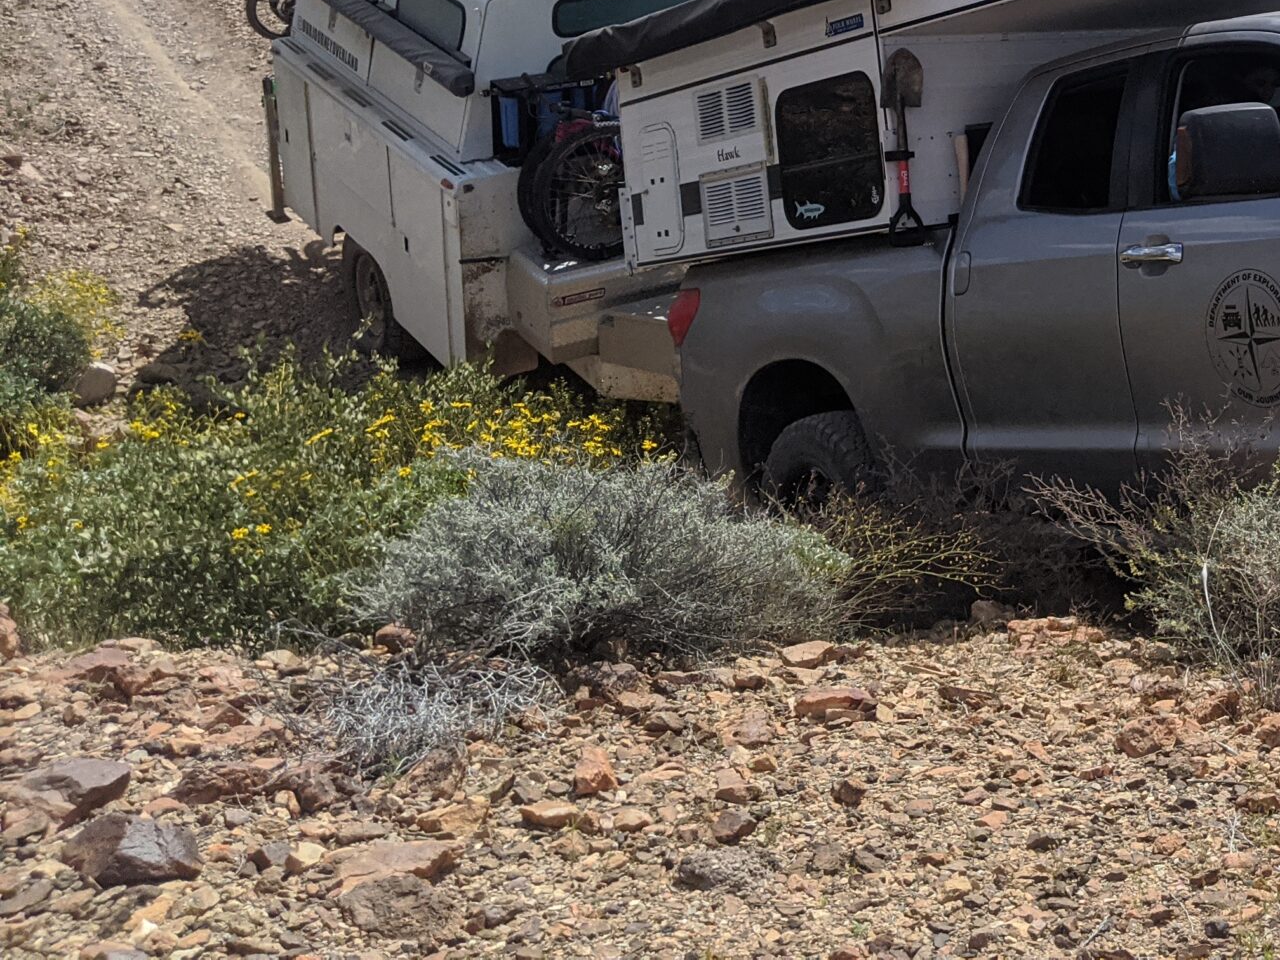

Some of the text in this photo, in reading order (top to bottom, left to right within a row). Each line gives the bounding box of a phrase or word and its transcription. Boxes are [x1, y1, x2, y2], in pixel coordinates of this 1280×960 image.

[717, 146, 741, 162] Hawk
[1208, 275, 1240, 328] DEPARTMENT
[1242, 272, 1252, 281] OF
[1237, 387, 1254, 401] OUR
